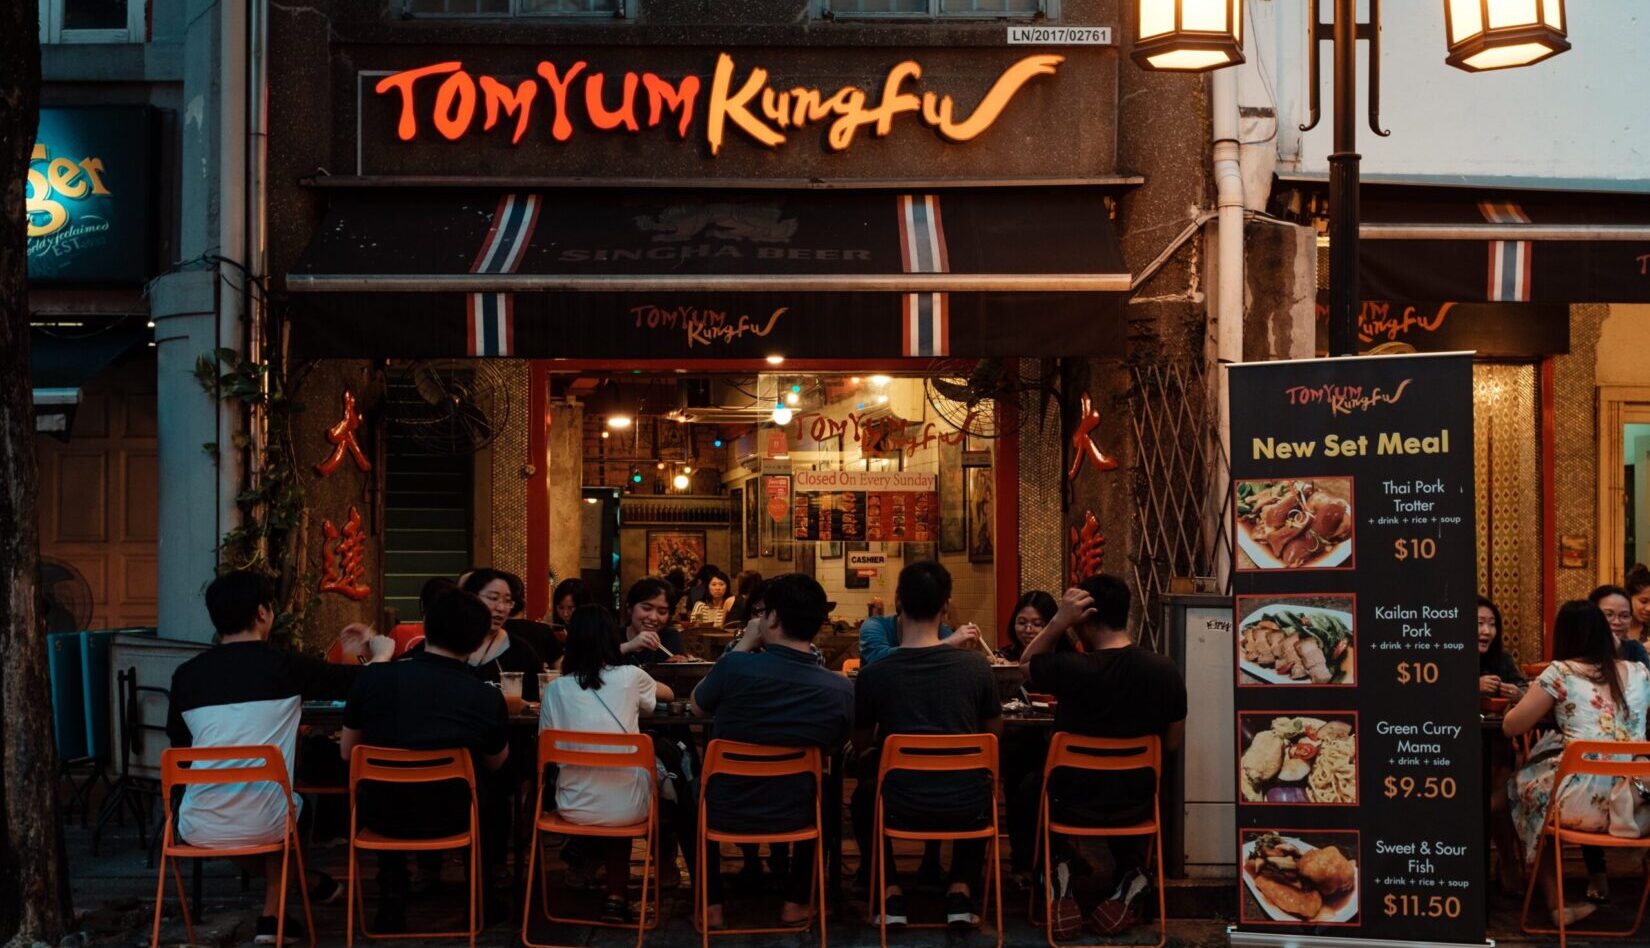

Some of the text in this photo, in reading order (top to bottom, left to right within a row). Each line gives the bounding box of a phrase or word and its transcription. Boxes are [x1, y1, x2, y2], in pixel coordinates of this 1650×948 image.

[1013, 28, 1108, 44] LN/2017/02761
[26, 143, 112, 237] ger
[757, 248, 873, 261] BEER
[1252, 429, 1449, 460] New Set Meal
[797, 472, 837, 487] Closed
[839, 472, 857, 486] On
[860, 472, 895, 489] Every
[893, 473, 935, 490] Sunday
[1382, 478, 1445, 495] Thai Pork
[1393, 499, 1435, 513] Trotter
[1377, 515, 1399, 525] drink
[1411, 516, 1428, 524] rice
[1440, 515, 1462, 524] soup
[1394, 538, 1437, 560] $10
[851, 555, 885, 564] CASHIER
[1375, 606, 1459, 620] Kailan Roast
[1402, 624, 1432, 638] Pork
[1380, 641, 1402, 650] drink
[1414, 641, 1431, 650] rice
[1443, 642, 1464, 651] soup
[1396, 660, 1439, 686] $10
[1376, 721, 1462, 740] Green Curry
[1397, 741, 1441, 754] Mama
[1398, 757, 1420, 766] drink
[1433, 757, 1450, 767] side
[1384, 775, 1457, 800] $9.50
[1376, 840, 1468, 856] Sweet & Sour
[1408, 858, 1435, 874] Fish
[1384, 877, 1406, 886] drink
[1418, 878, 1435, 887] rice
[1448, 879, 1469, 888] soup
[1384, 893, 1462, 919] $11.50
